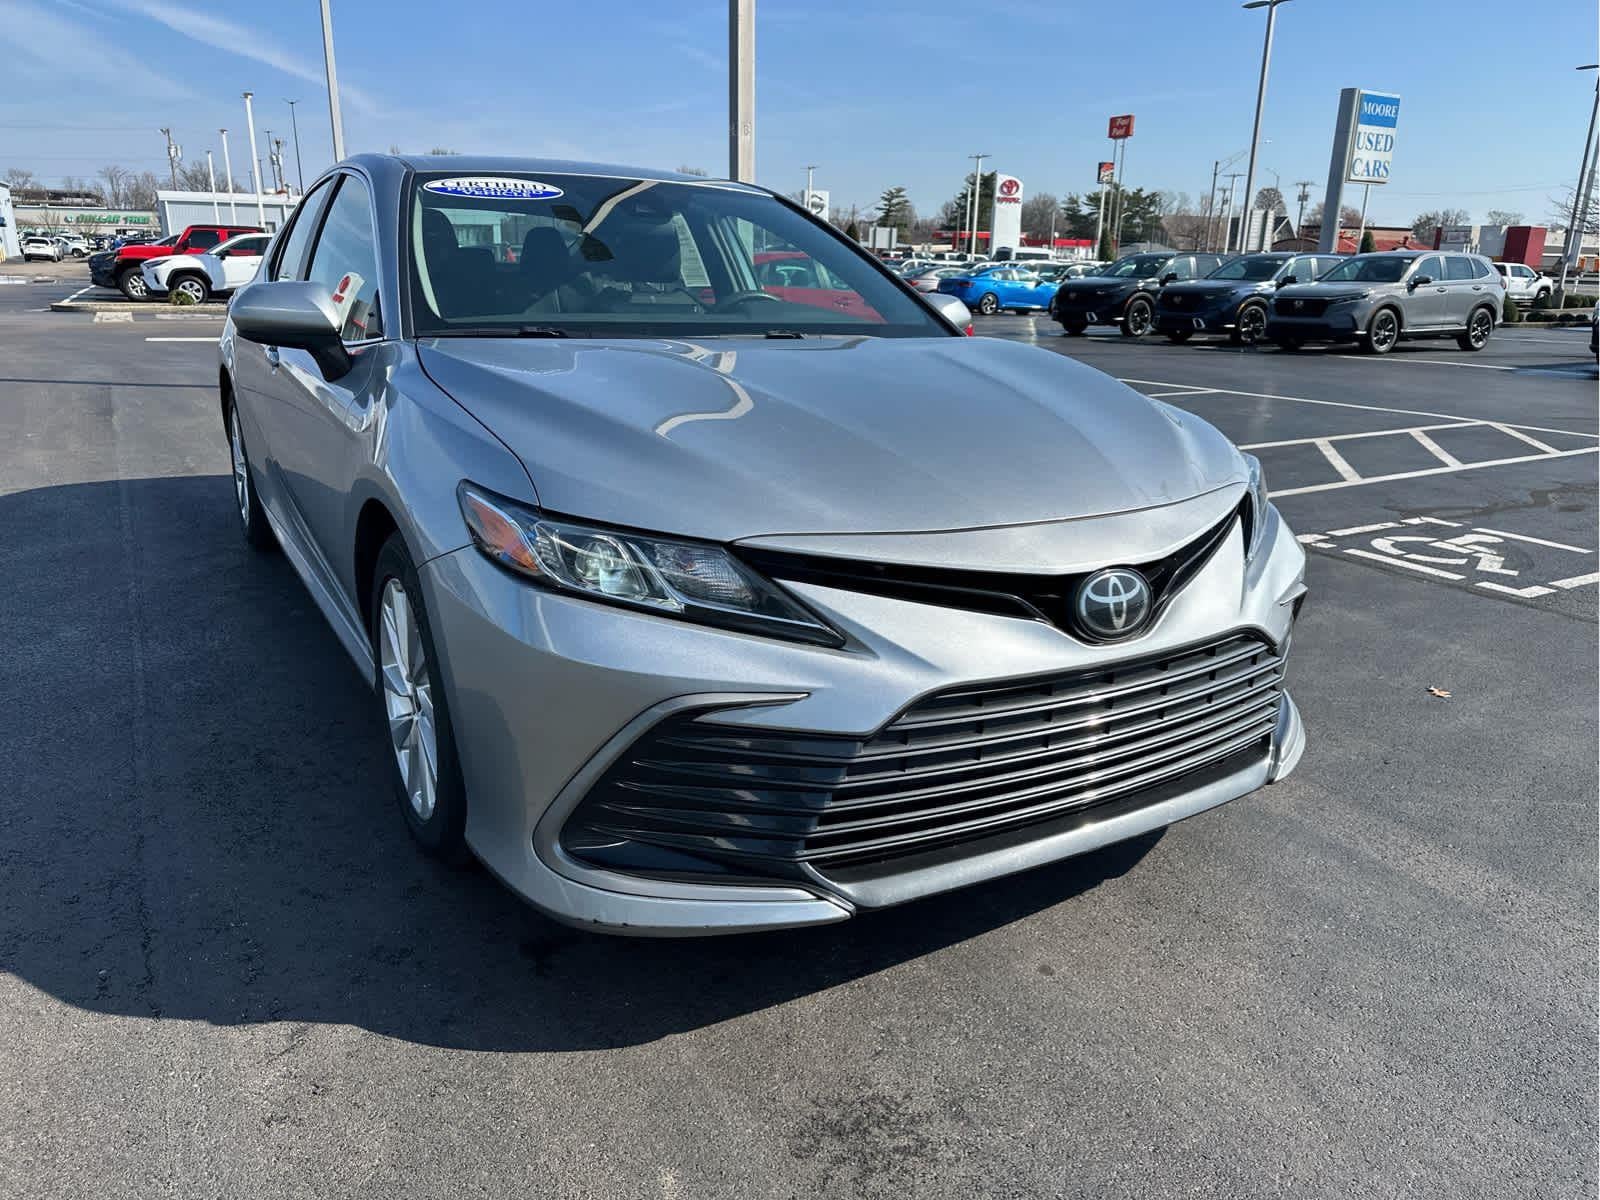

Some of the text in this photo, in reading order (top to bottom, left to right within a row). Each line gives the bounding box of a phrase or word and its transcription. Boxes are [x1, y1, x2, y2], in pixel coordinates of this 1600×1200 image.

[1363, 102, 1397, 117] MOORE
[1357, 132, 1393, 152] USED
[1352, 158, 1390, 178] CARS
[441, 180, 546, 190] CERTIFIED
